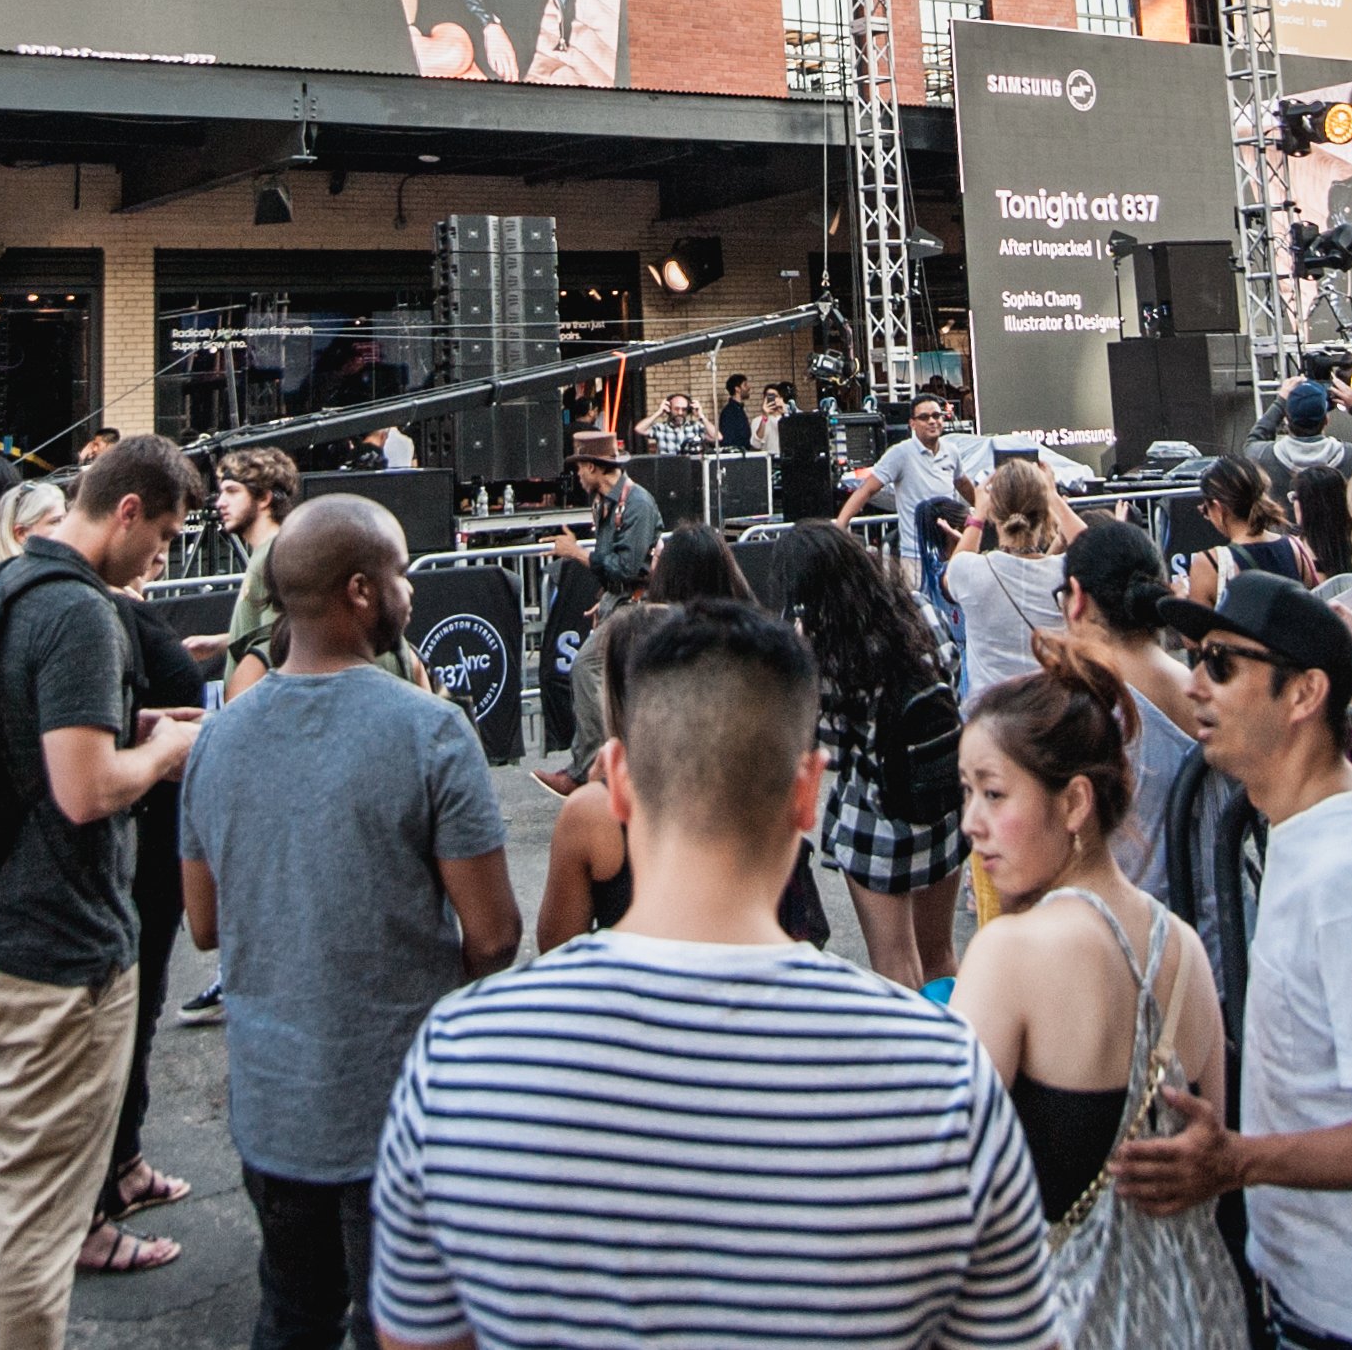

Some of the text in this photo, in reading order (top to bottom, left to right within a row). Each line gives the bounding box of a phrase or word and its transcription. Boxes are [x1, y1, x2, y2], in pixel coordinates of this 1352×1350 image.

[987, 73, 1063, 97] SAMSUNG
[995, 188, 1160, 229] Tonight at 837
[999, 238, 1031, 256] After
[1033, 239, 1093, 259] Unpacked
[1002, 290, 1082, 310] Sophia Chang
[1004, 313, 1124, 333] Illustrator & Designe
[1045, 429, 1060, 446] at
[424, 620, 499, 659] WASHINGTON STREET
[462, 654, 491, 672] NYC
